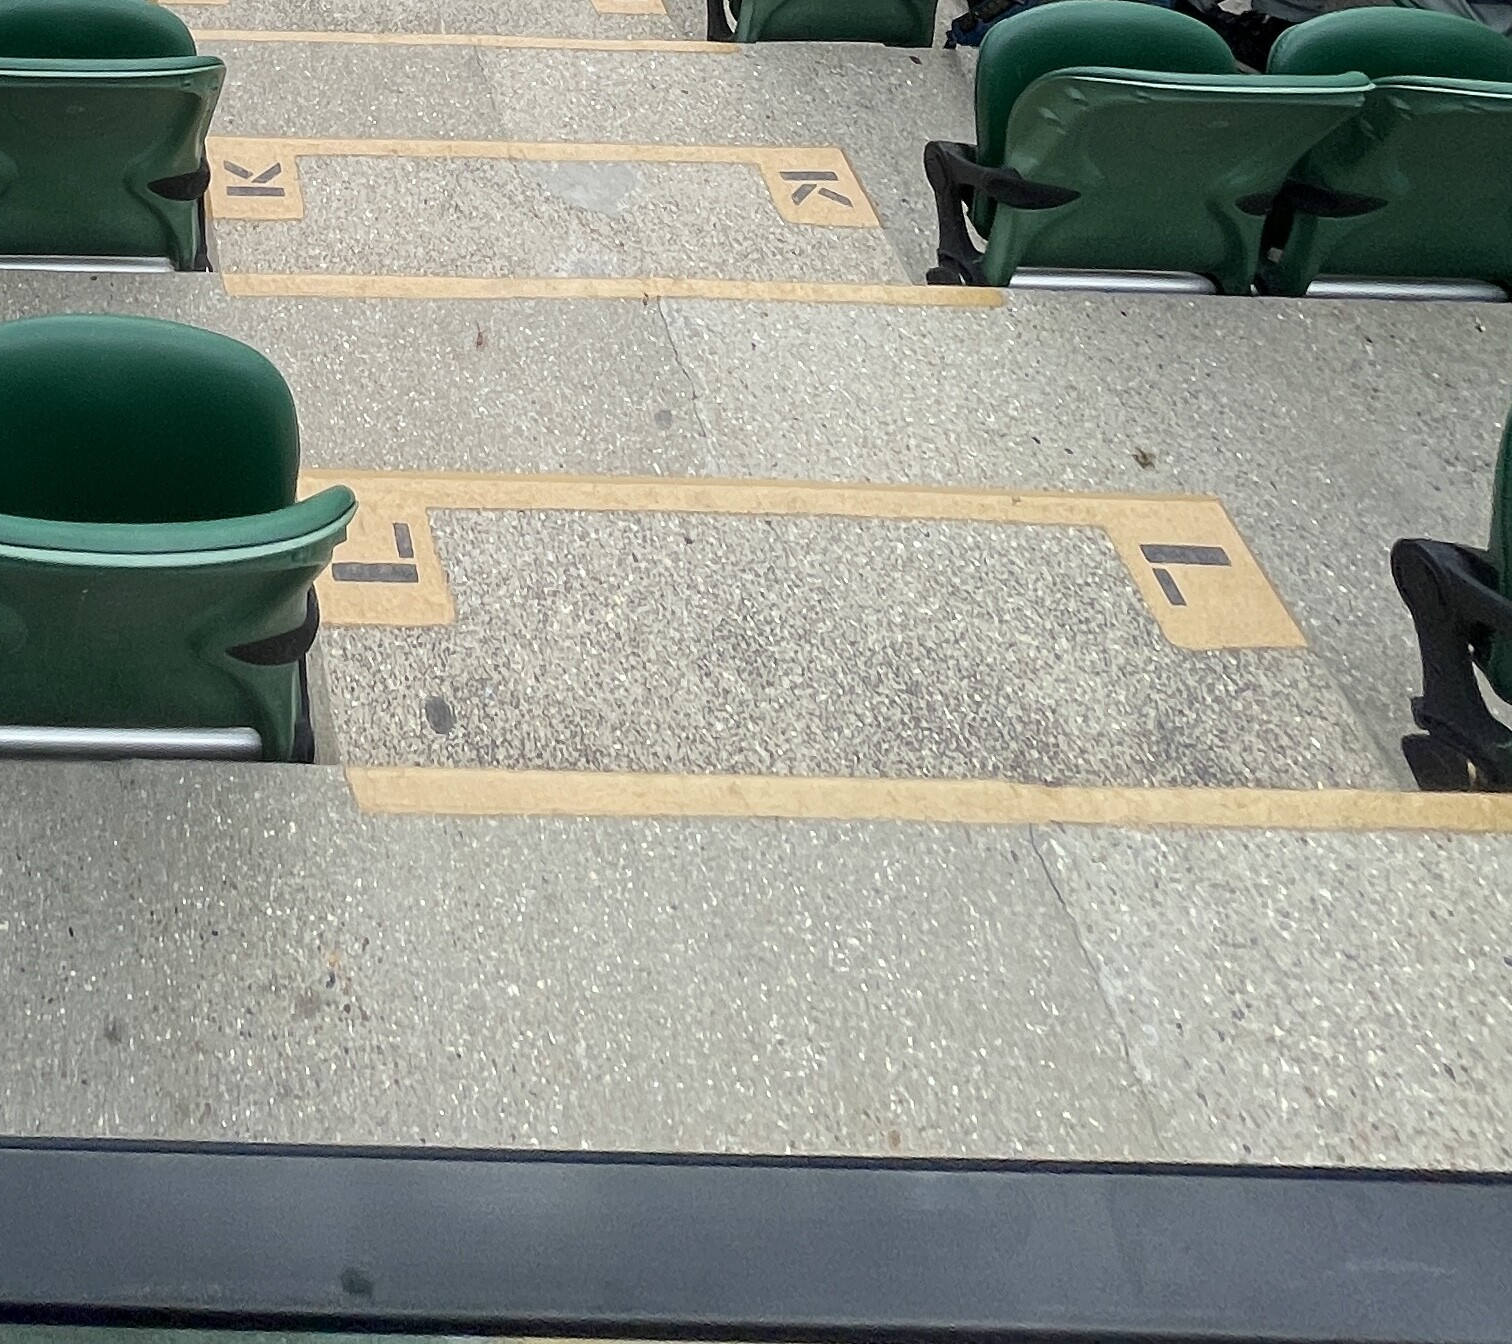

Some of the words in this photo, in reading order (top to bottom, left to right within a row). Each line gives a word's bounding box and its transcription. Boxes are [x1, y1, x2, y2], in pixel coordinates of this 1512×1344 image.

[223, 159, 286, 198] K
[778, 170, 855, 209] K
[331, 522, 419, 583] L
[1139, 543, 1232, 607] L
